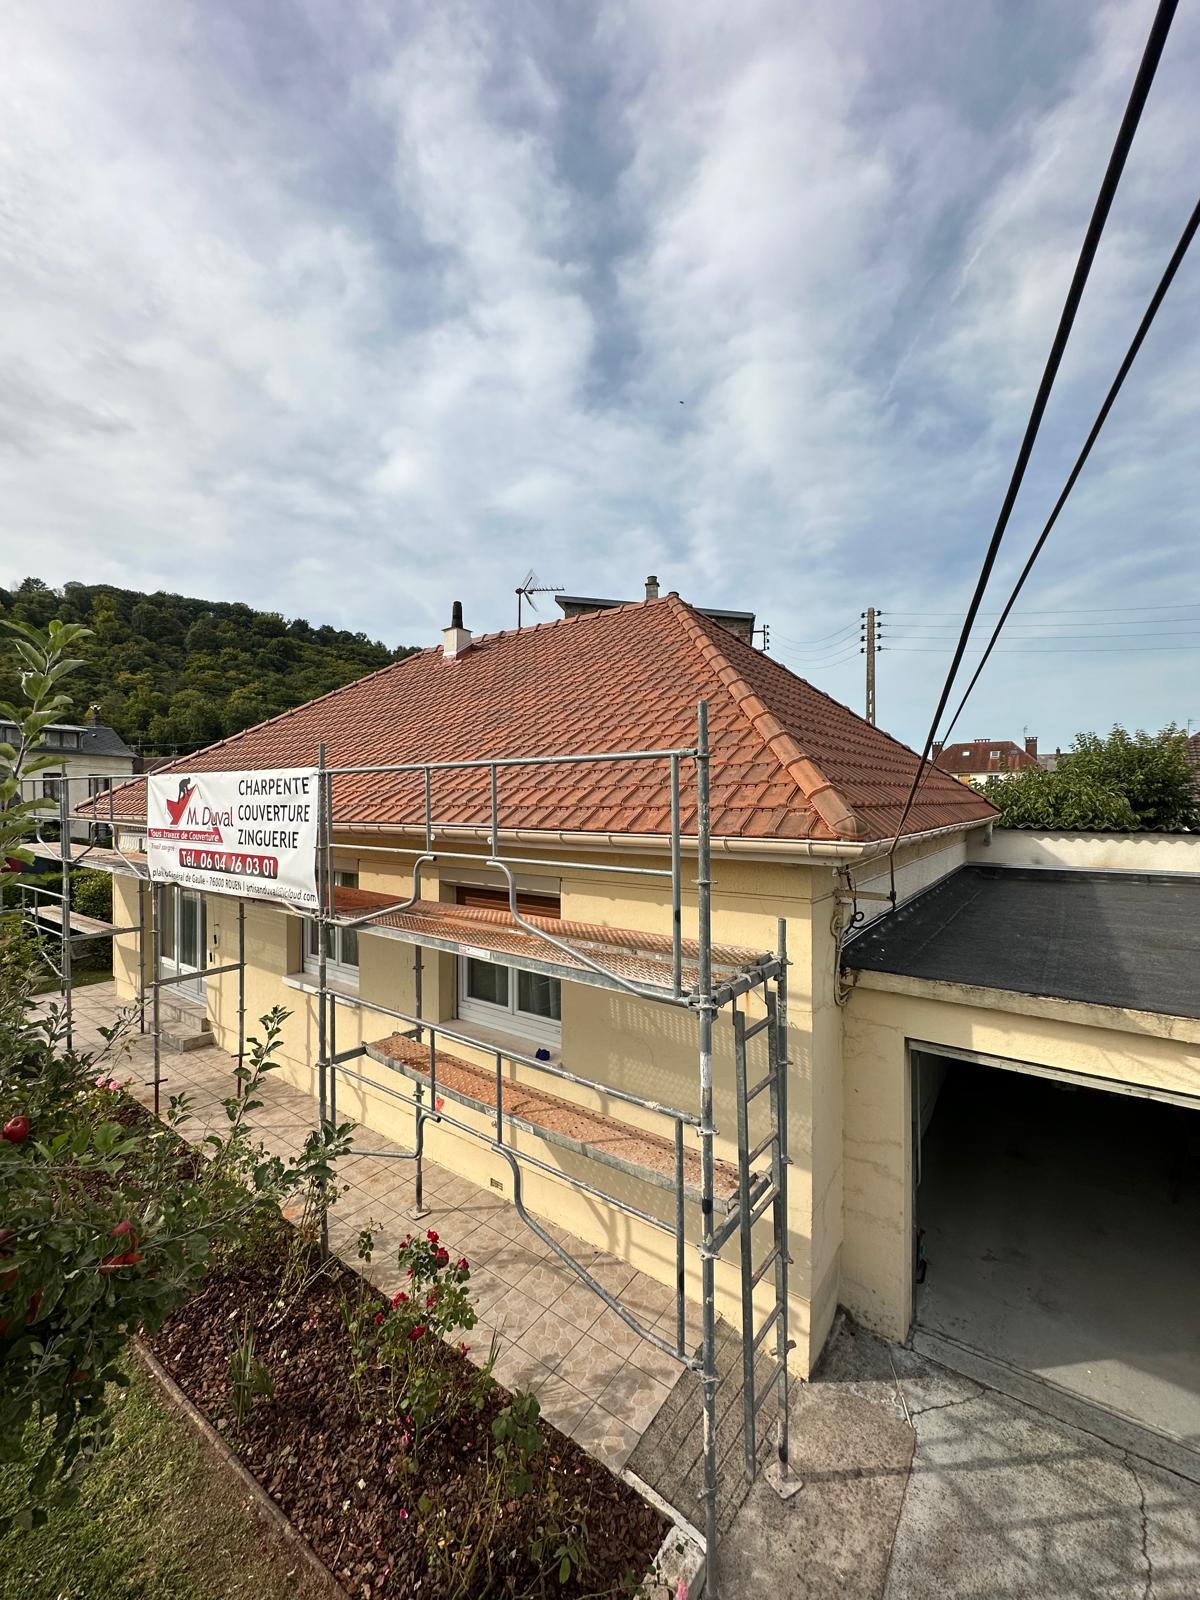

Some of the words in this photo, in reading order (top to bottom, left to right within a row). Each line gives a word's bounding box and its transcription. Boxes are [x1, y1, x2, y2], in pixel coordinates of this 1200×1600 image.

[238, 777, 310, 796] CHARPENTE
[186, 807, 200, 825] M.
[202, 807, 234, 827] Duval
[238, 805, 311, 822] COUVERTURE
[150, 829, 162, 838] Tous
[180, 831, 188, 840] de
[189, 832, 220, 841] Couverture
[238, 829, 299, 849] ZINGUERIE
[181, 850, 197, 867] Tél.
[200, 852, 212, 869] 06
[214, 854, 226, 871] 04
[230, 855, 242, 873] 16
[246, 857, 260, 875] 03
[263, 858, 274, 877] 01
[209, 876, 224, 888] 76000
[225, 878, 242, 891] ROUEN
